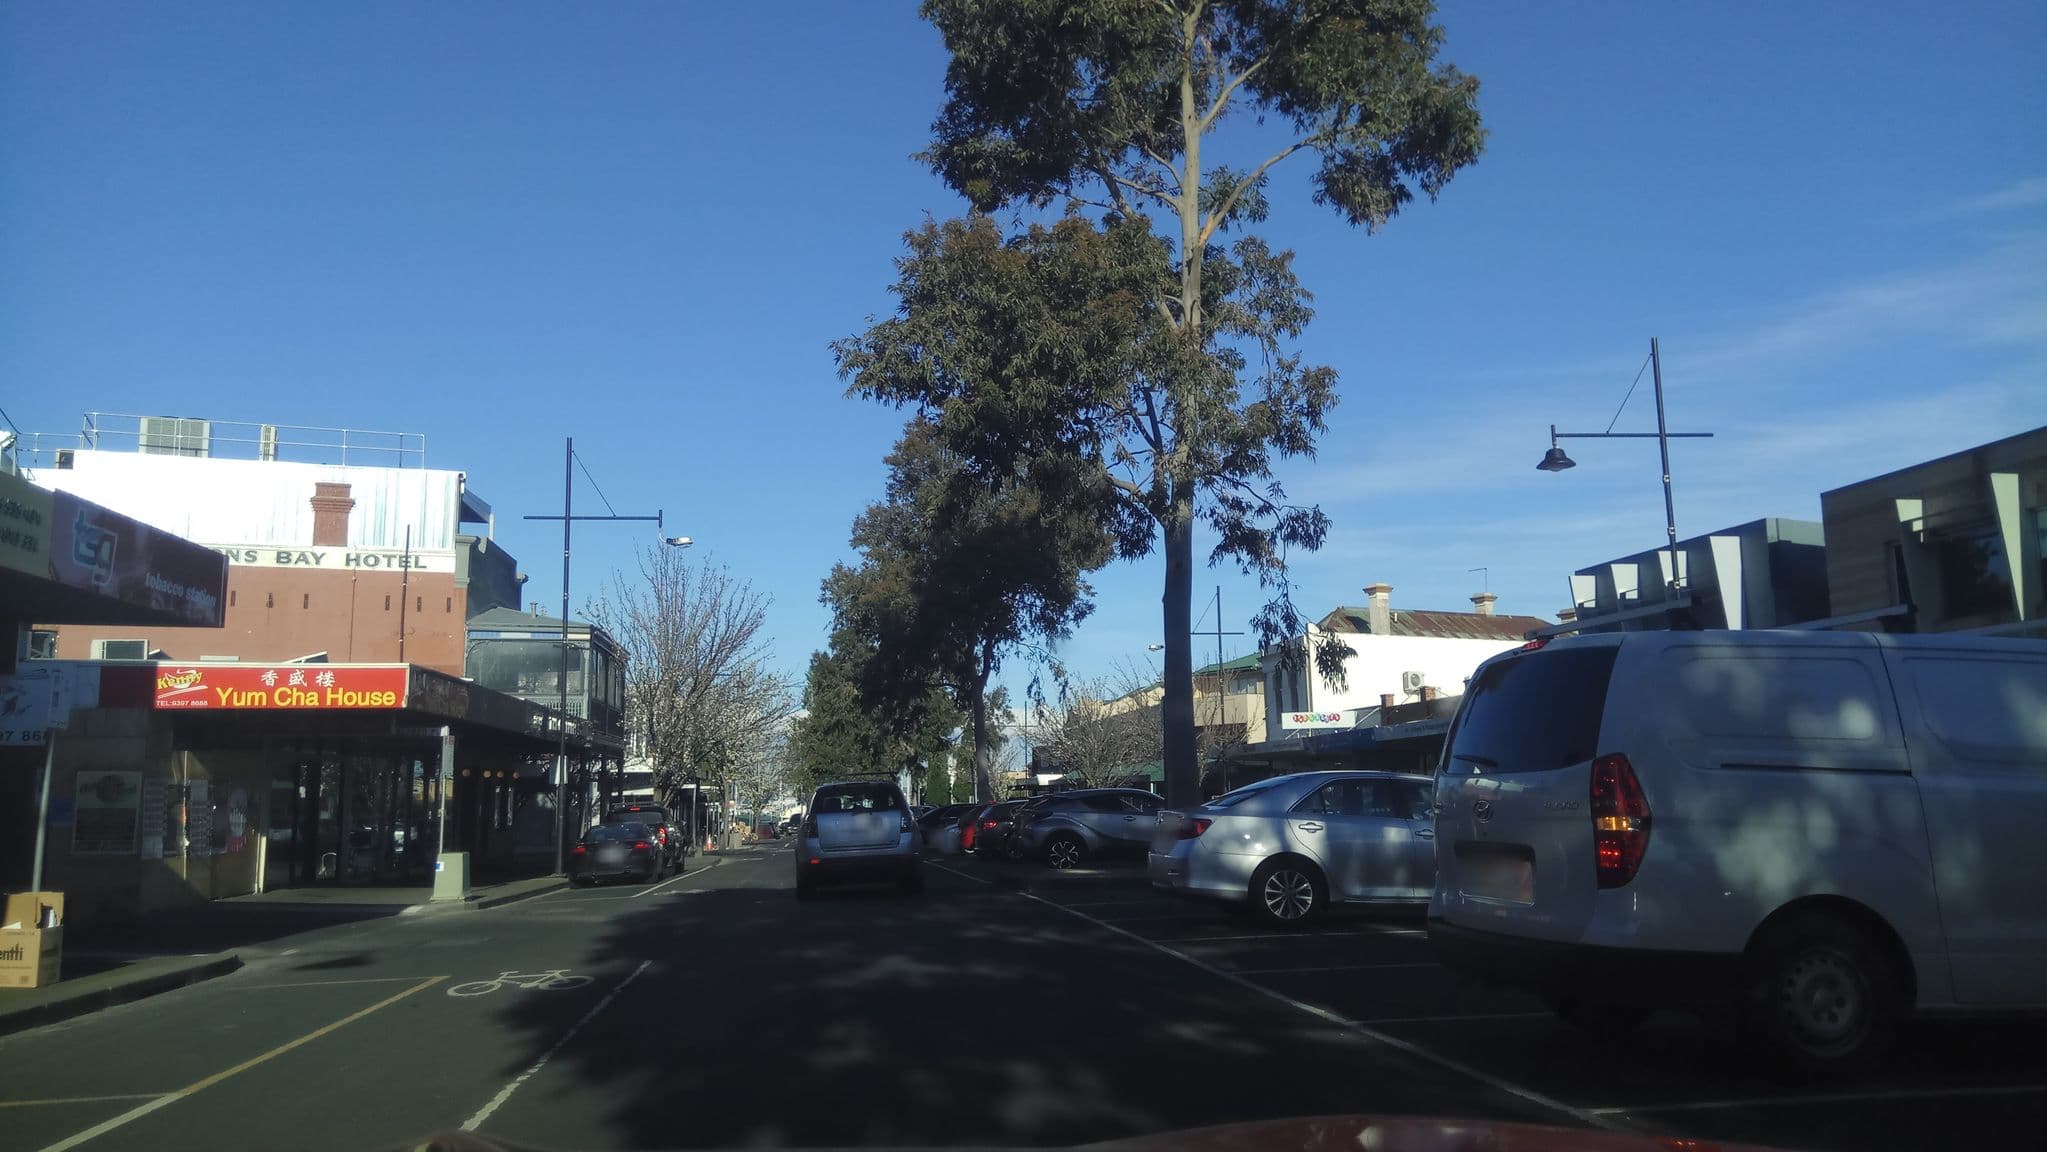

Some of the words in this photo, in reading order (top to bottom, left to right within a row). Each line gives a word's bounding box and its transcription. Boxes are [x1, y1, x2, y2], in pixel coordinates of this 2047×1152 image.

[275, 550, 328, 565] BAY
[345, 552, 428, 569] HOTEL
[145, 571, 184, 598] tobacco
[156, 672, 203, 690] Kenny
[216, 687, 267, 707] Yum
[273, 686, 320, 707] Cha
[326, 686, 396, 707] House
